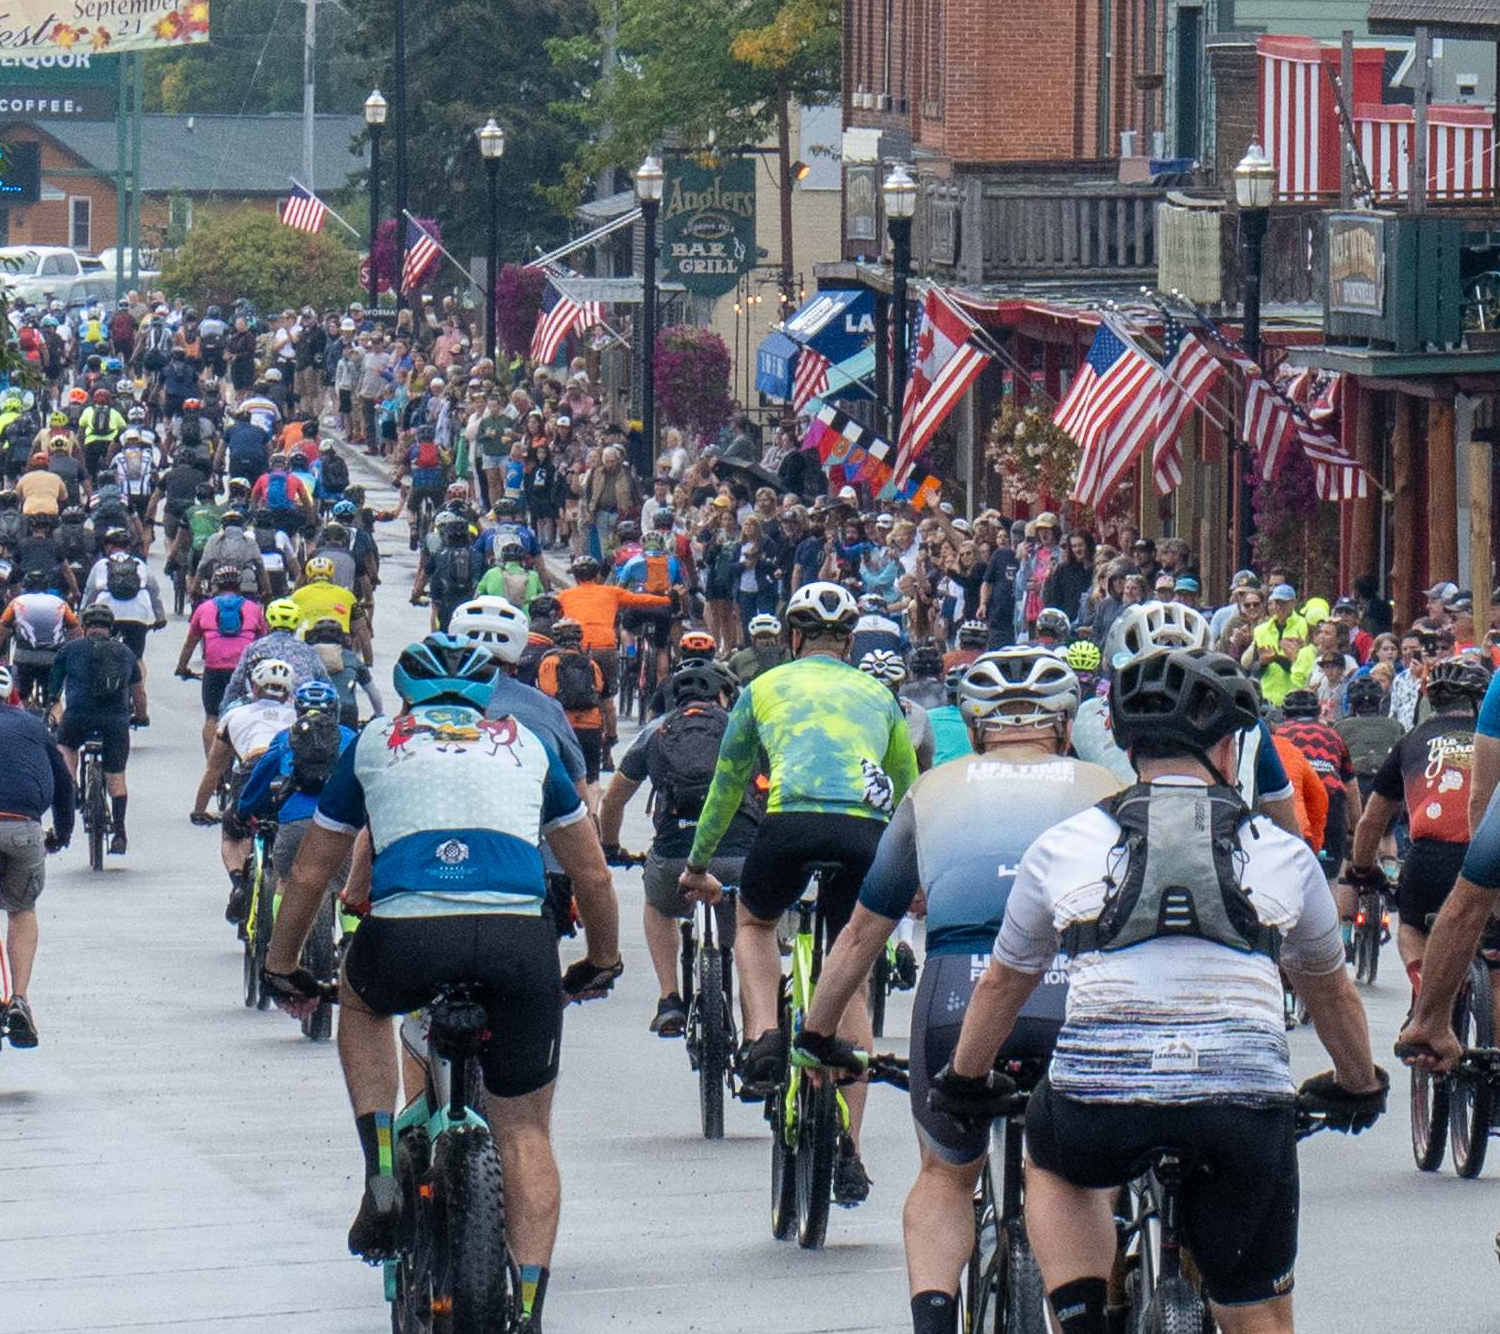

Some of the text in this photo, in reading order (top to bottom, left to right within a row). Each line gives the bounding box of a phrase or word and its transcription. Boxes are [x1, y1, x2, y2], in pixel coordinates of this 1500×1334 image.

[665, 176, 755, 220] Anglers
[671, 242, 728, 258] BAR
[679, 259, 739, 275] GRILL
[966, 761, 1076, 777] LIFE TIME
[965, 773, 1076, 784] FOUNDATION
